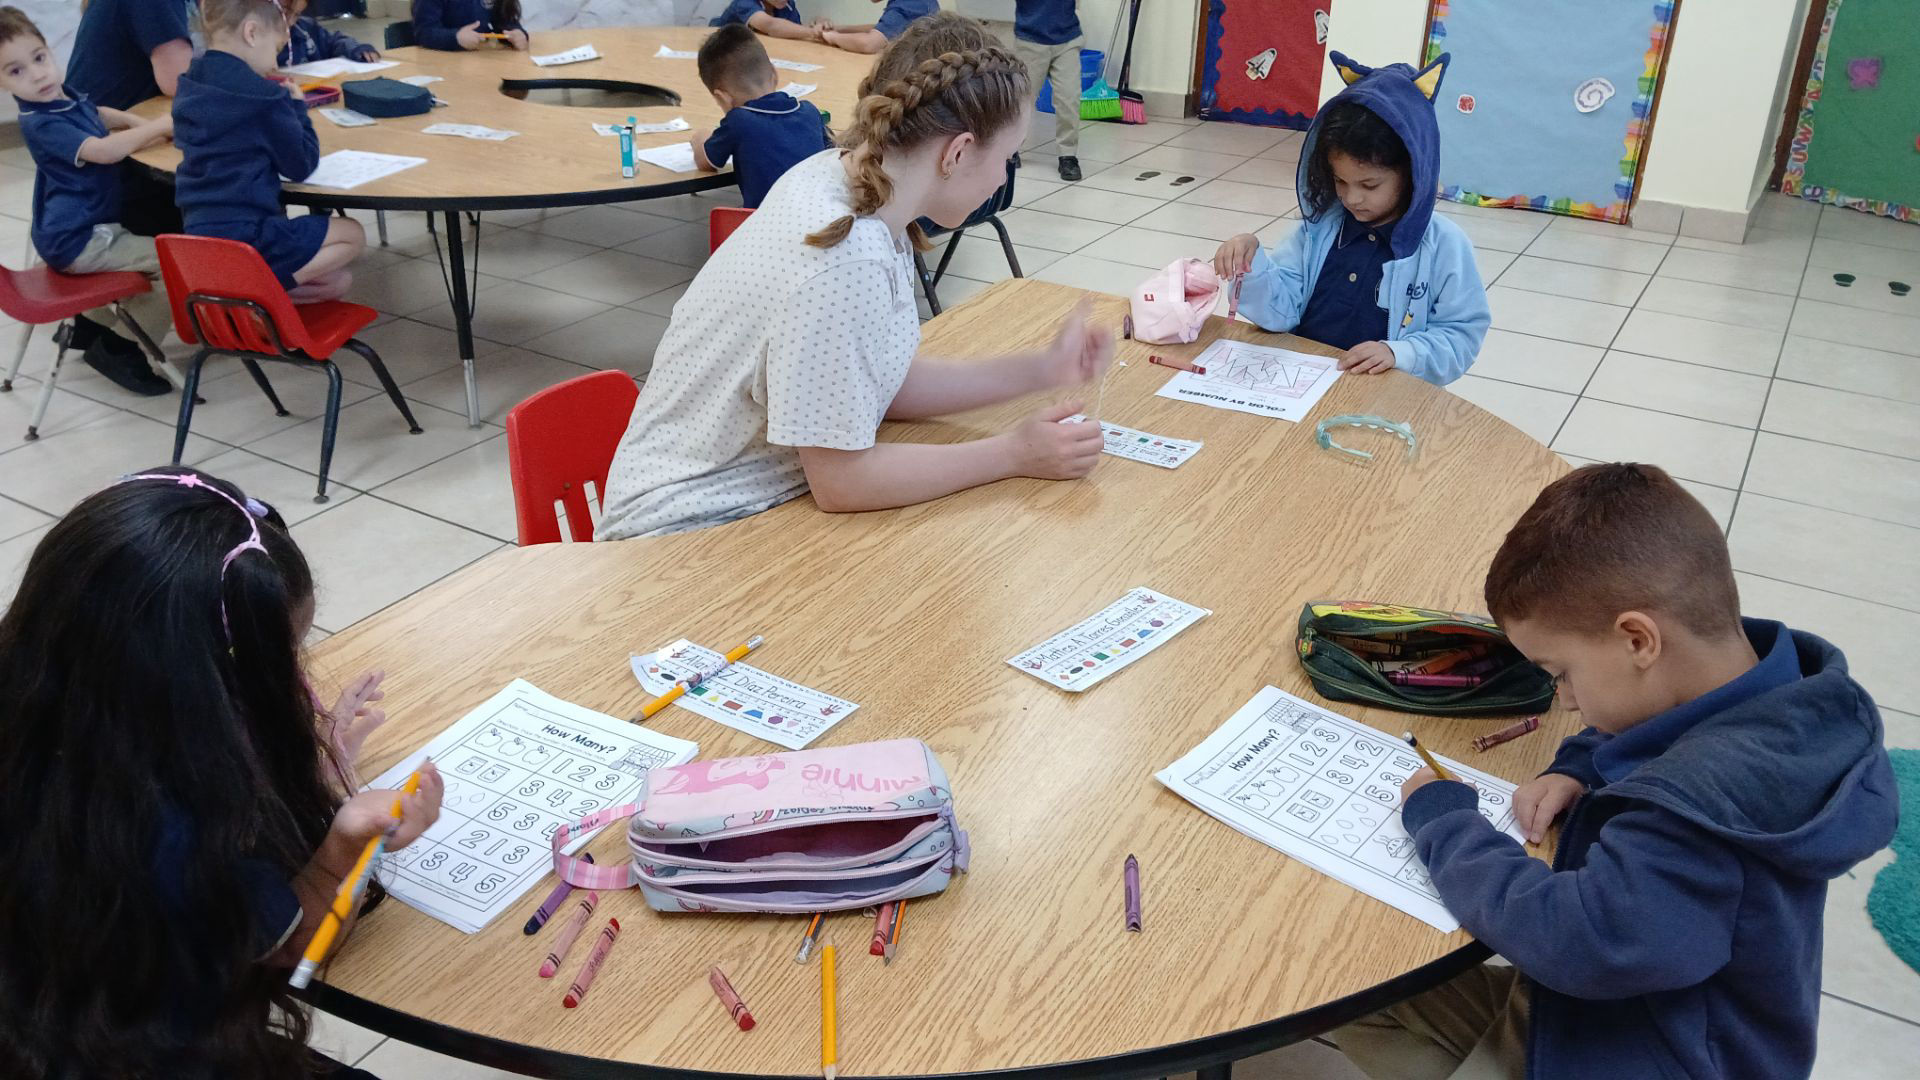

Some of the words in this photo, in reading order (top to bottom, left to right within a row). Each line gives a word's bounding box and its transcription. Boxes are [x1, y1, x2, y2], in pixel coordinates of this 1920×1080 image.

[1179, 388, 1228, 401] NUMBER
[1247, 402, 1286, 412] COLOR
[540, 723, 571, 739] How
[570, 733, 617, 754] Many?
[1300, 740, 1328, 757] 2
[1314, 728, 1341, 743] 3
[1228, 753, 1254, 772] How
[1247, 728, 1280, 755] Many?
[1354, 739, 1384, 757] 2
[1339, 754, 1369, 770] 4
[1393, 755, 1423, 771] 4
[567, 765, 597, 782] 2
[595, 774, 620, 791] 3
[1326, 769, 1354, 785] 3
[1380, 771, 1408, 787] 3
[519, 779, 545, 797] 3
[546, 788, 573, 808] 4
[569, 799, 599, 817] 2
[1364, 784, 1394, 802] 5
[1478, 787, 1505, 805] 5
[487, 802, 517, 821] 5
[513, 812, 540, 831] 3
[458, 829, 490, 849] 2
[502, 845, 530, 864] 3
[420, 851, 449, 871] 3
[449, 862, 477, 884] 4
[474, 872, 506, 894] 5
